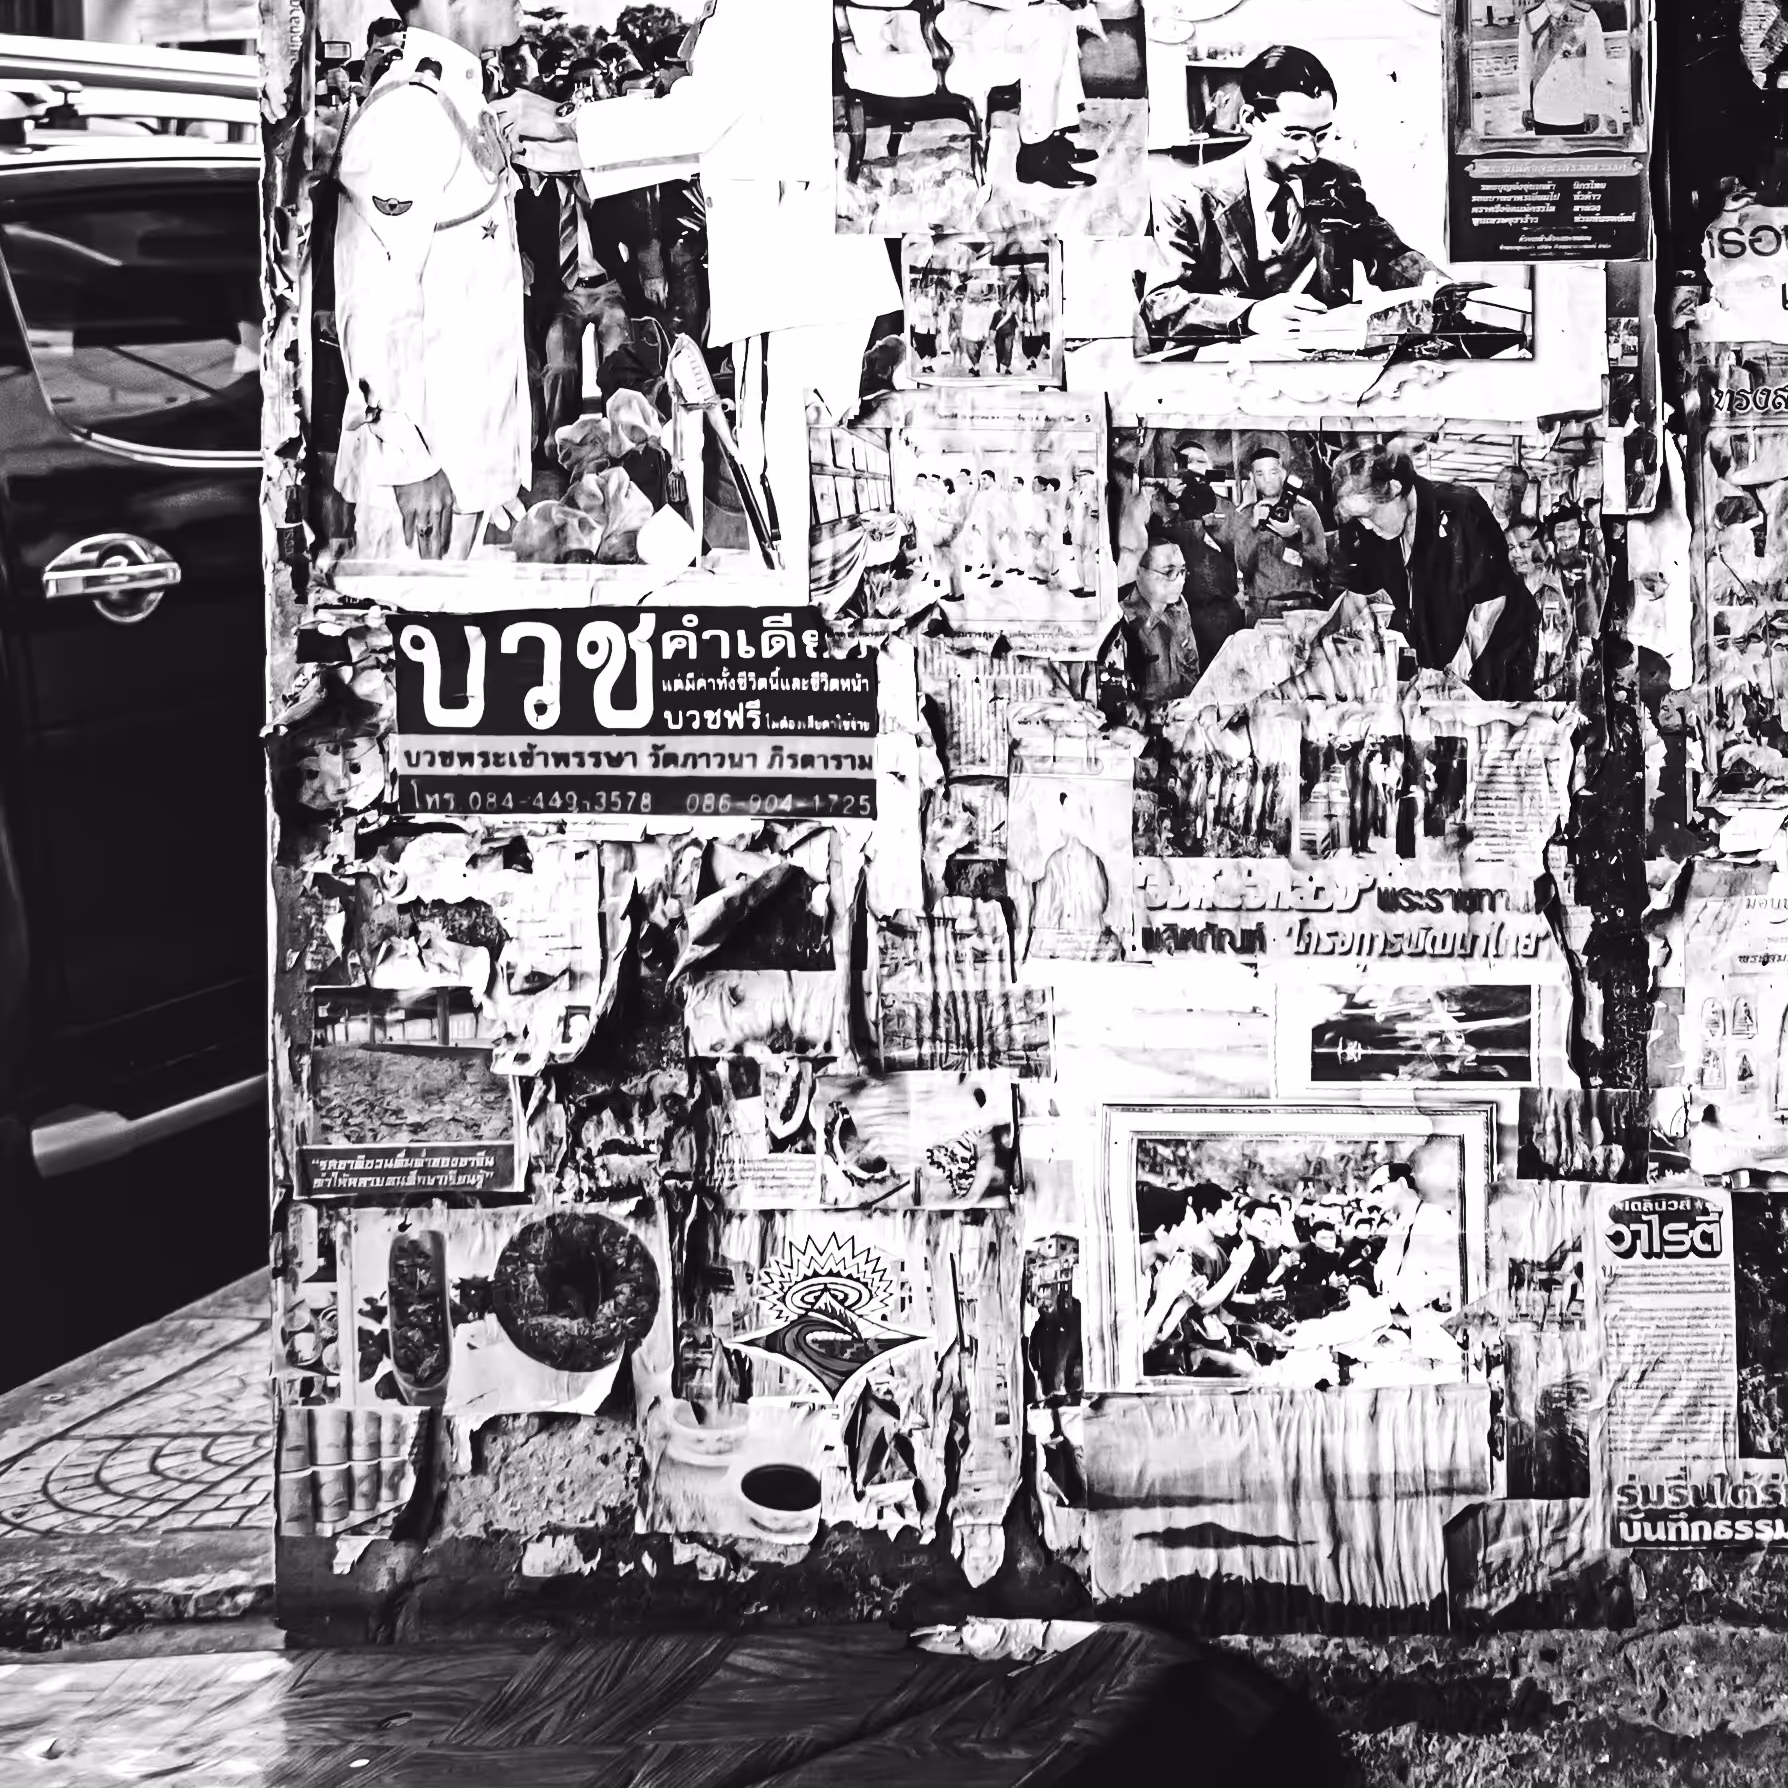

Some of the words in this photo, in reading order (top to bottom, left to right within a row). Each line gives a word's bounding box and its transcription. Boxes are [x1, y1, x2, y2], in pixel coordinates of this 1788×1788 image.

[398, 612, 657, 730] บวช
[662, 701, 762, 731] บวชฟรี
[468, 789, 653, 814] 084-449-3578
[685, 791, 872, 816] 086-904-1725
